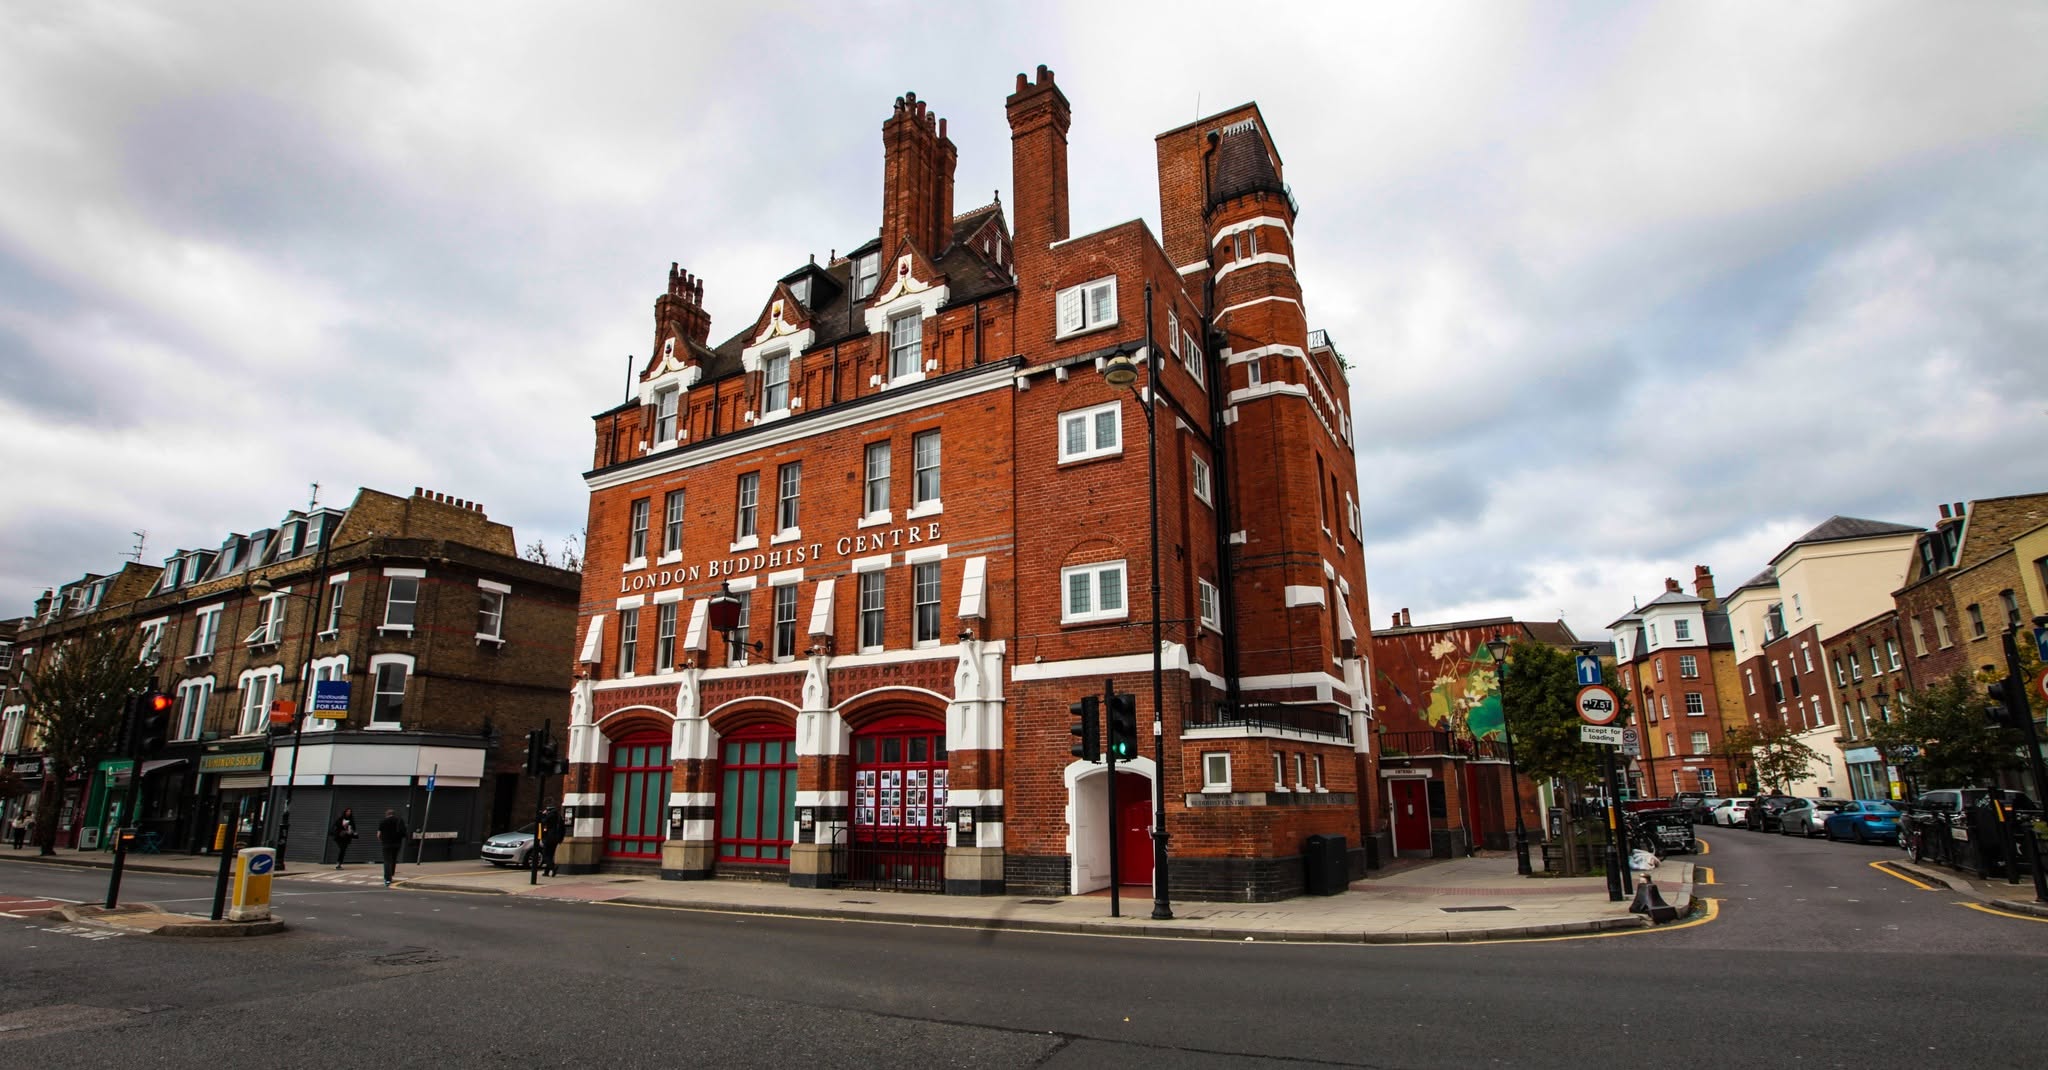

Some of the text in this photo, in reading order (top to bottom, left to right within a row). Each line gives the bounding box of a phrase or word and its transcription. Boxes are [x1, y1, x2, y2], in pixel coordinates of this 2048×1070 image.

[620, 522, 941, 592] LONDON BUDDHIST CENTRE
[1582, 726, 1621, 735] Except for
[1589, 734, 1615, 742] loading
